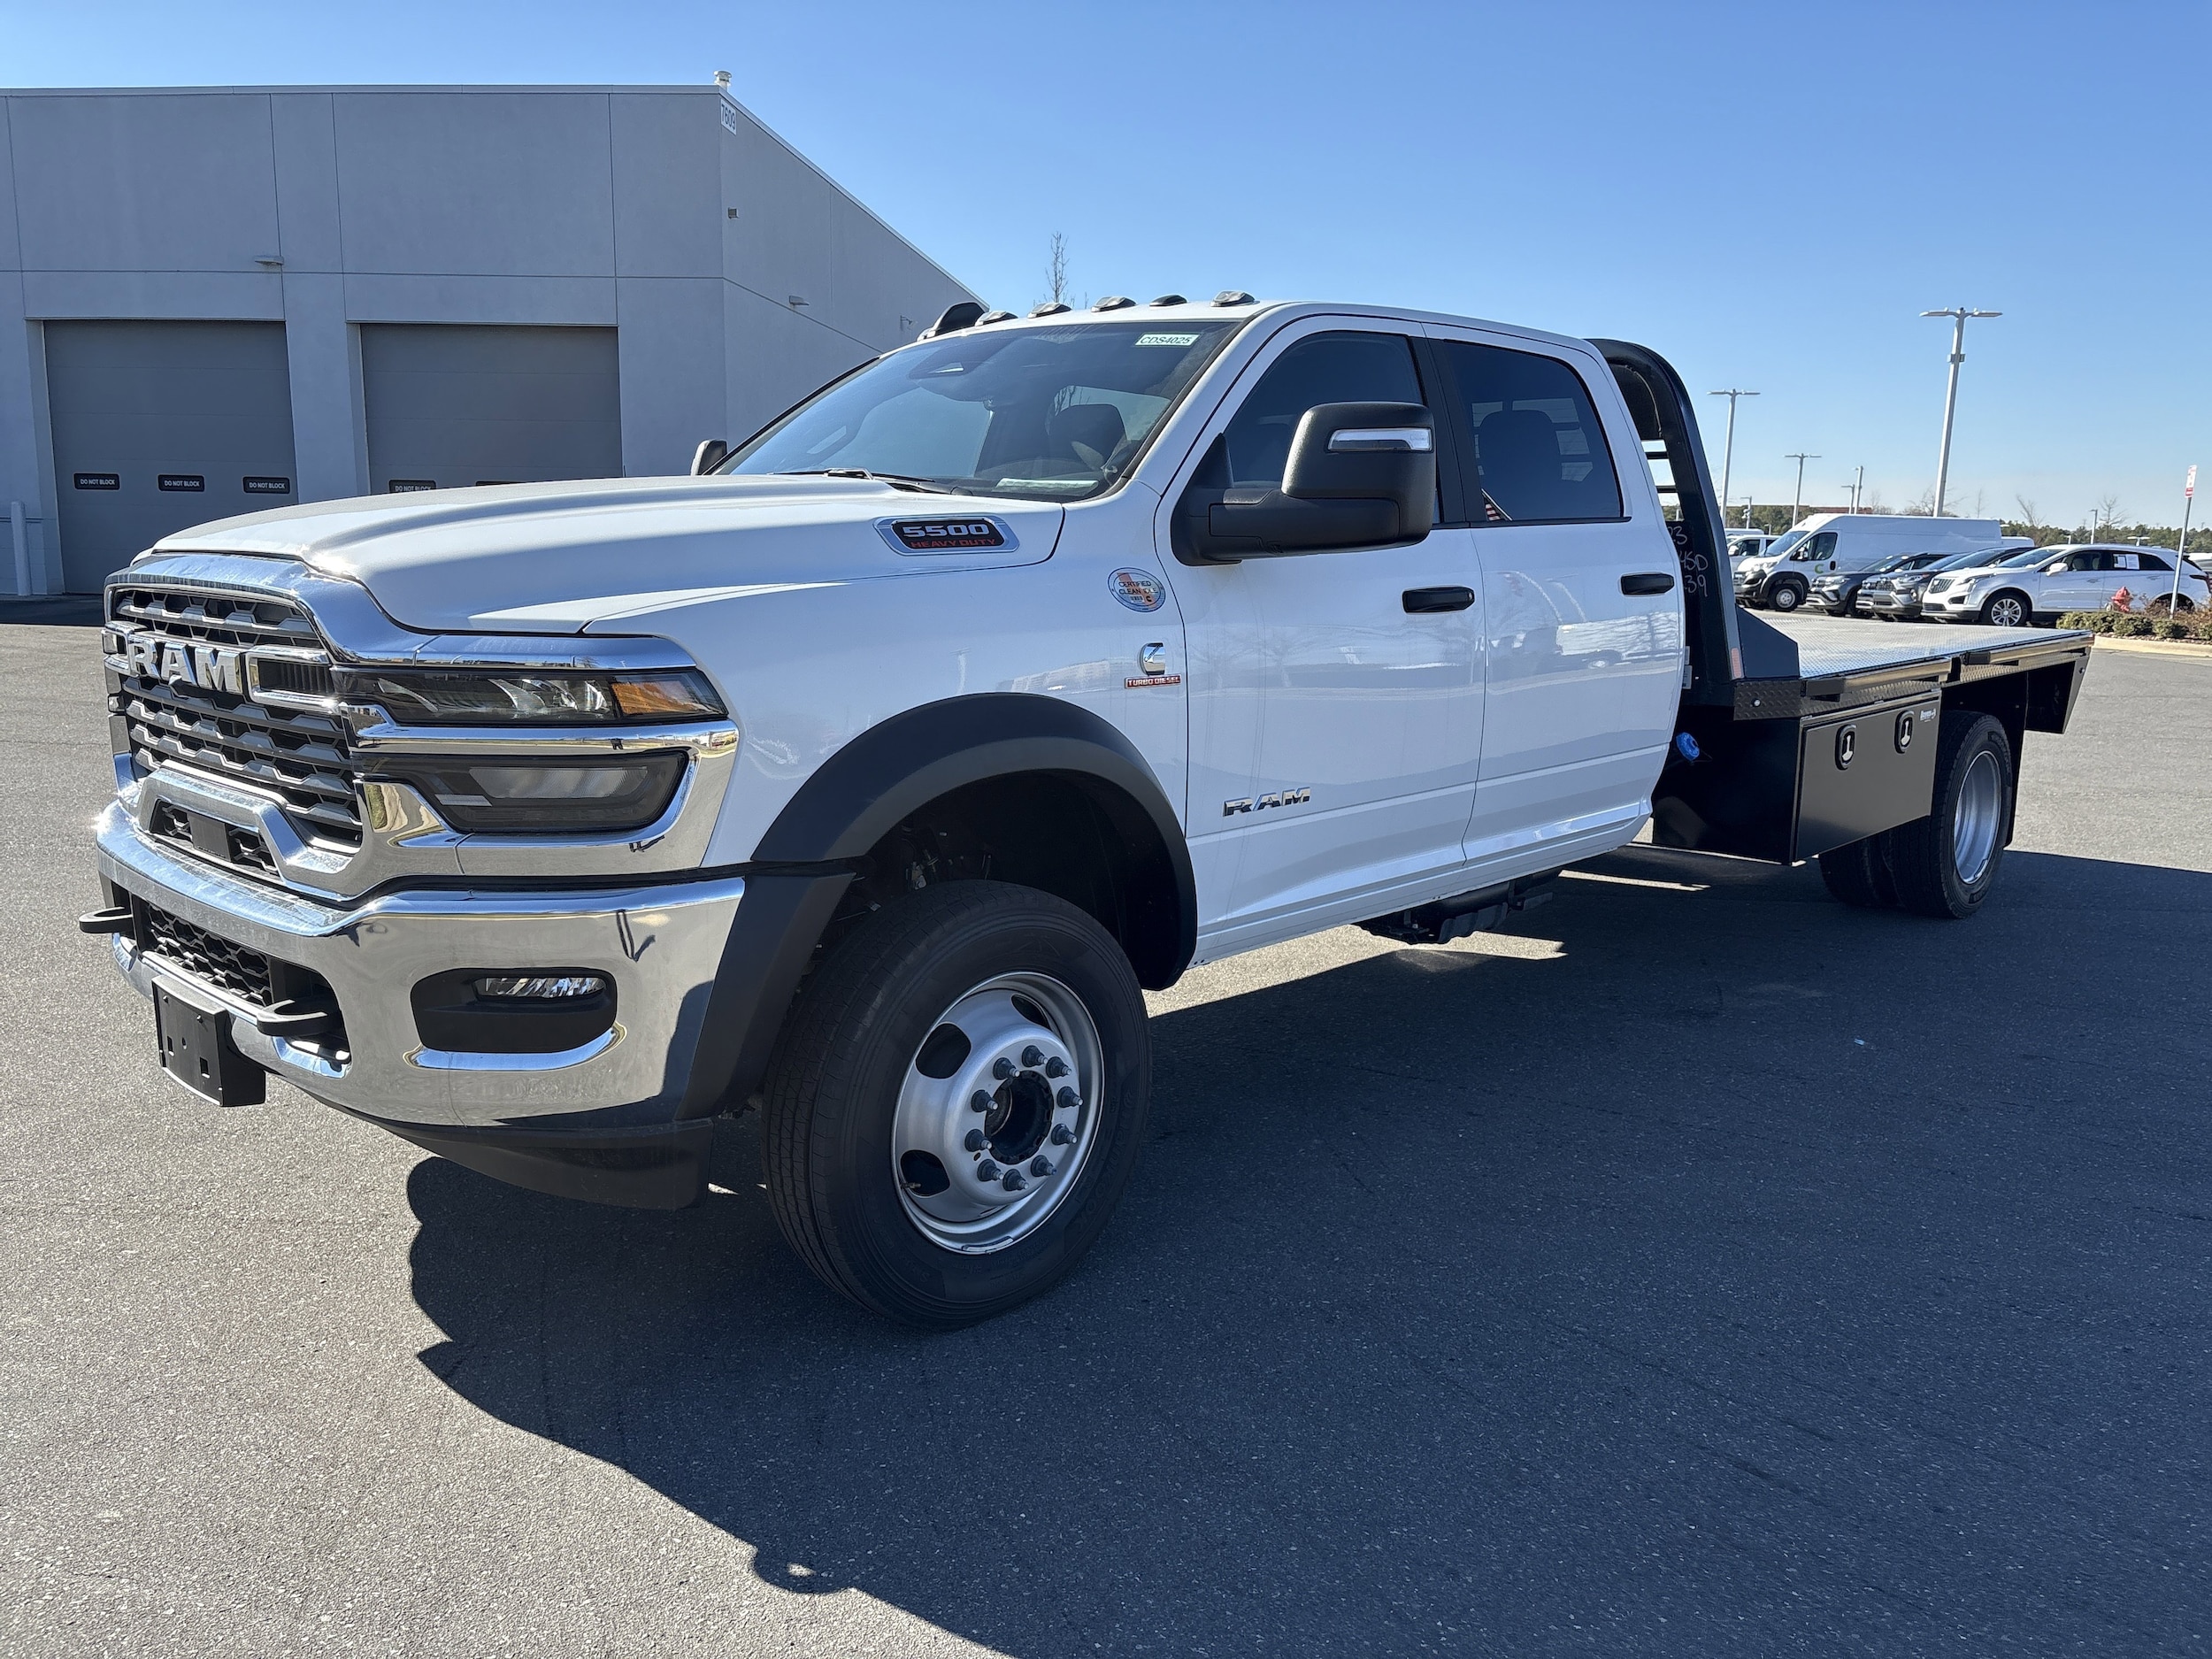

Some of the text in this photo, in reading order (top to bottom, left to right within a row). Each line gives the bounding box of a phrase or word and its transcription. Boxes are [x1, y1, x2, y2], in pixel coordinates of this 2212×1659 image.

[902, 524, 989, 537] 5500
[1684, 574, 1708, 597] 39
[127, 634, 243, 695] RAM
[1222, 787, 1310, 817] RAM
